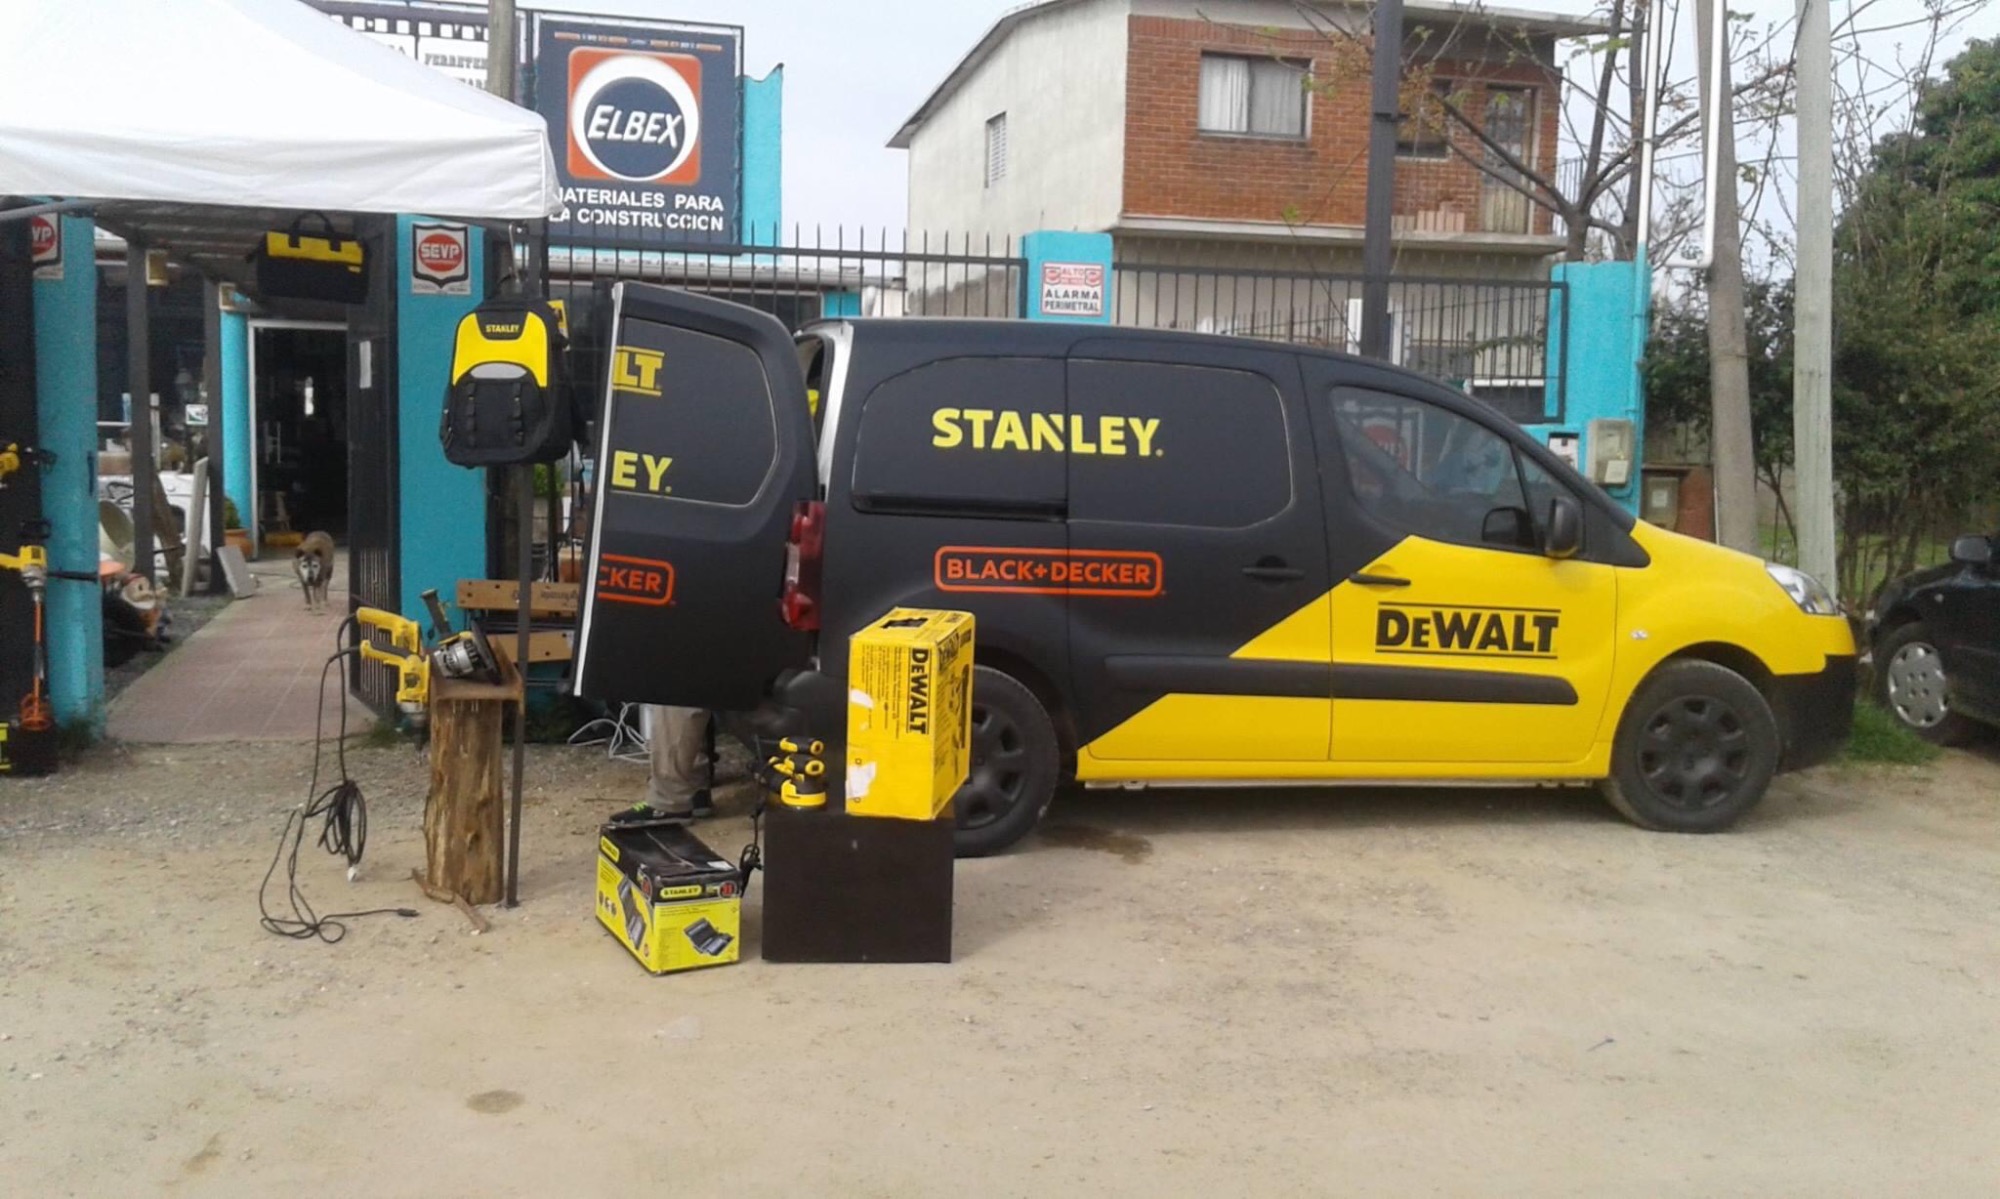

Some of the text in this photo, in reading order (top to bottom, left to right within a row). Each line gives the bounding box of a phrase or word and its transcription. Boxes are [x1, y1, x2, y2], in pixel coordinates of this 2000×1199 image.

[588, 105, 682, 148] ELBEX
[674, 193, 724, 211] PARA
[420, 243, 460, 259] SEVP
[1045, 289, 1099, 300] ALARMA
[1045, 300, 1098, 312] PERIMETRAL
[486, 324, 519, 333] STANLEY
[932, 408, 1160, 456] STANLEY
[611, 450, 673, 492] EY
[946, 558, 1151, 583] BLACK+DECKER
